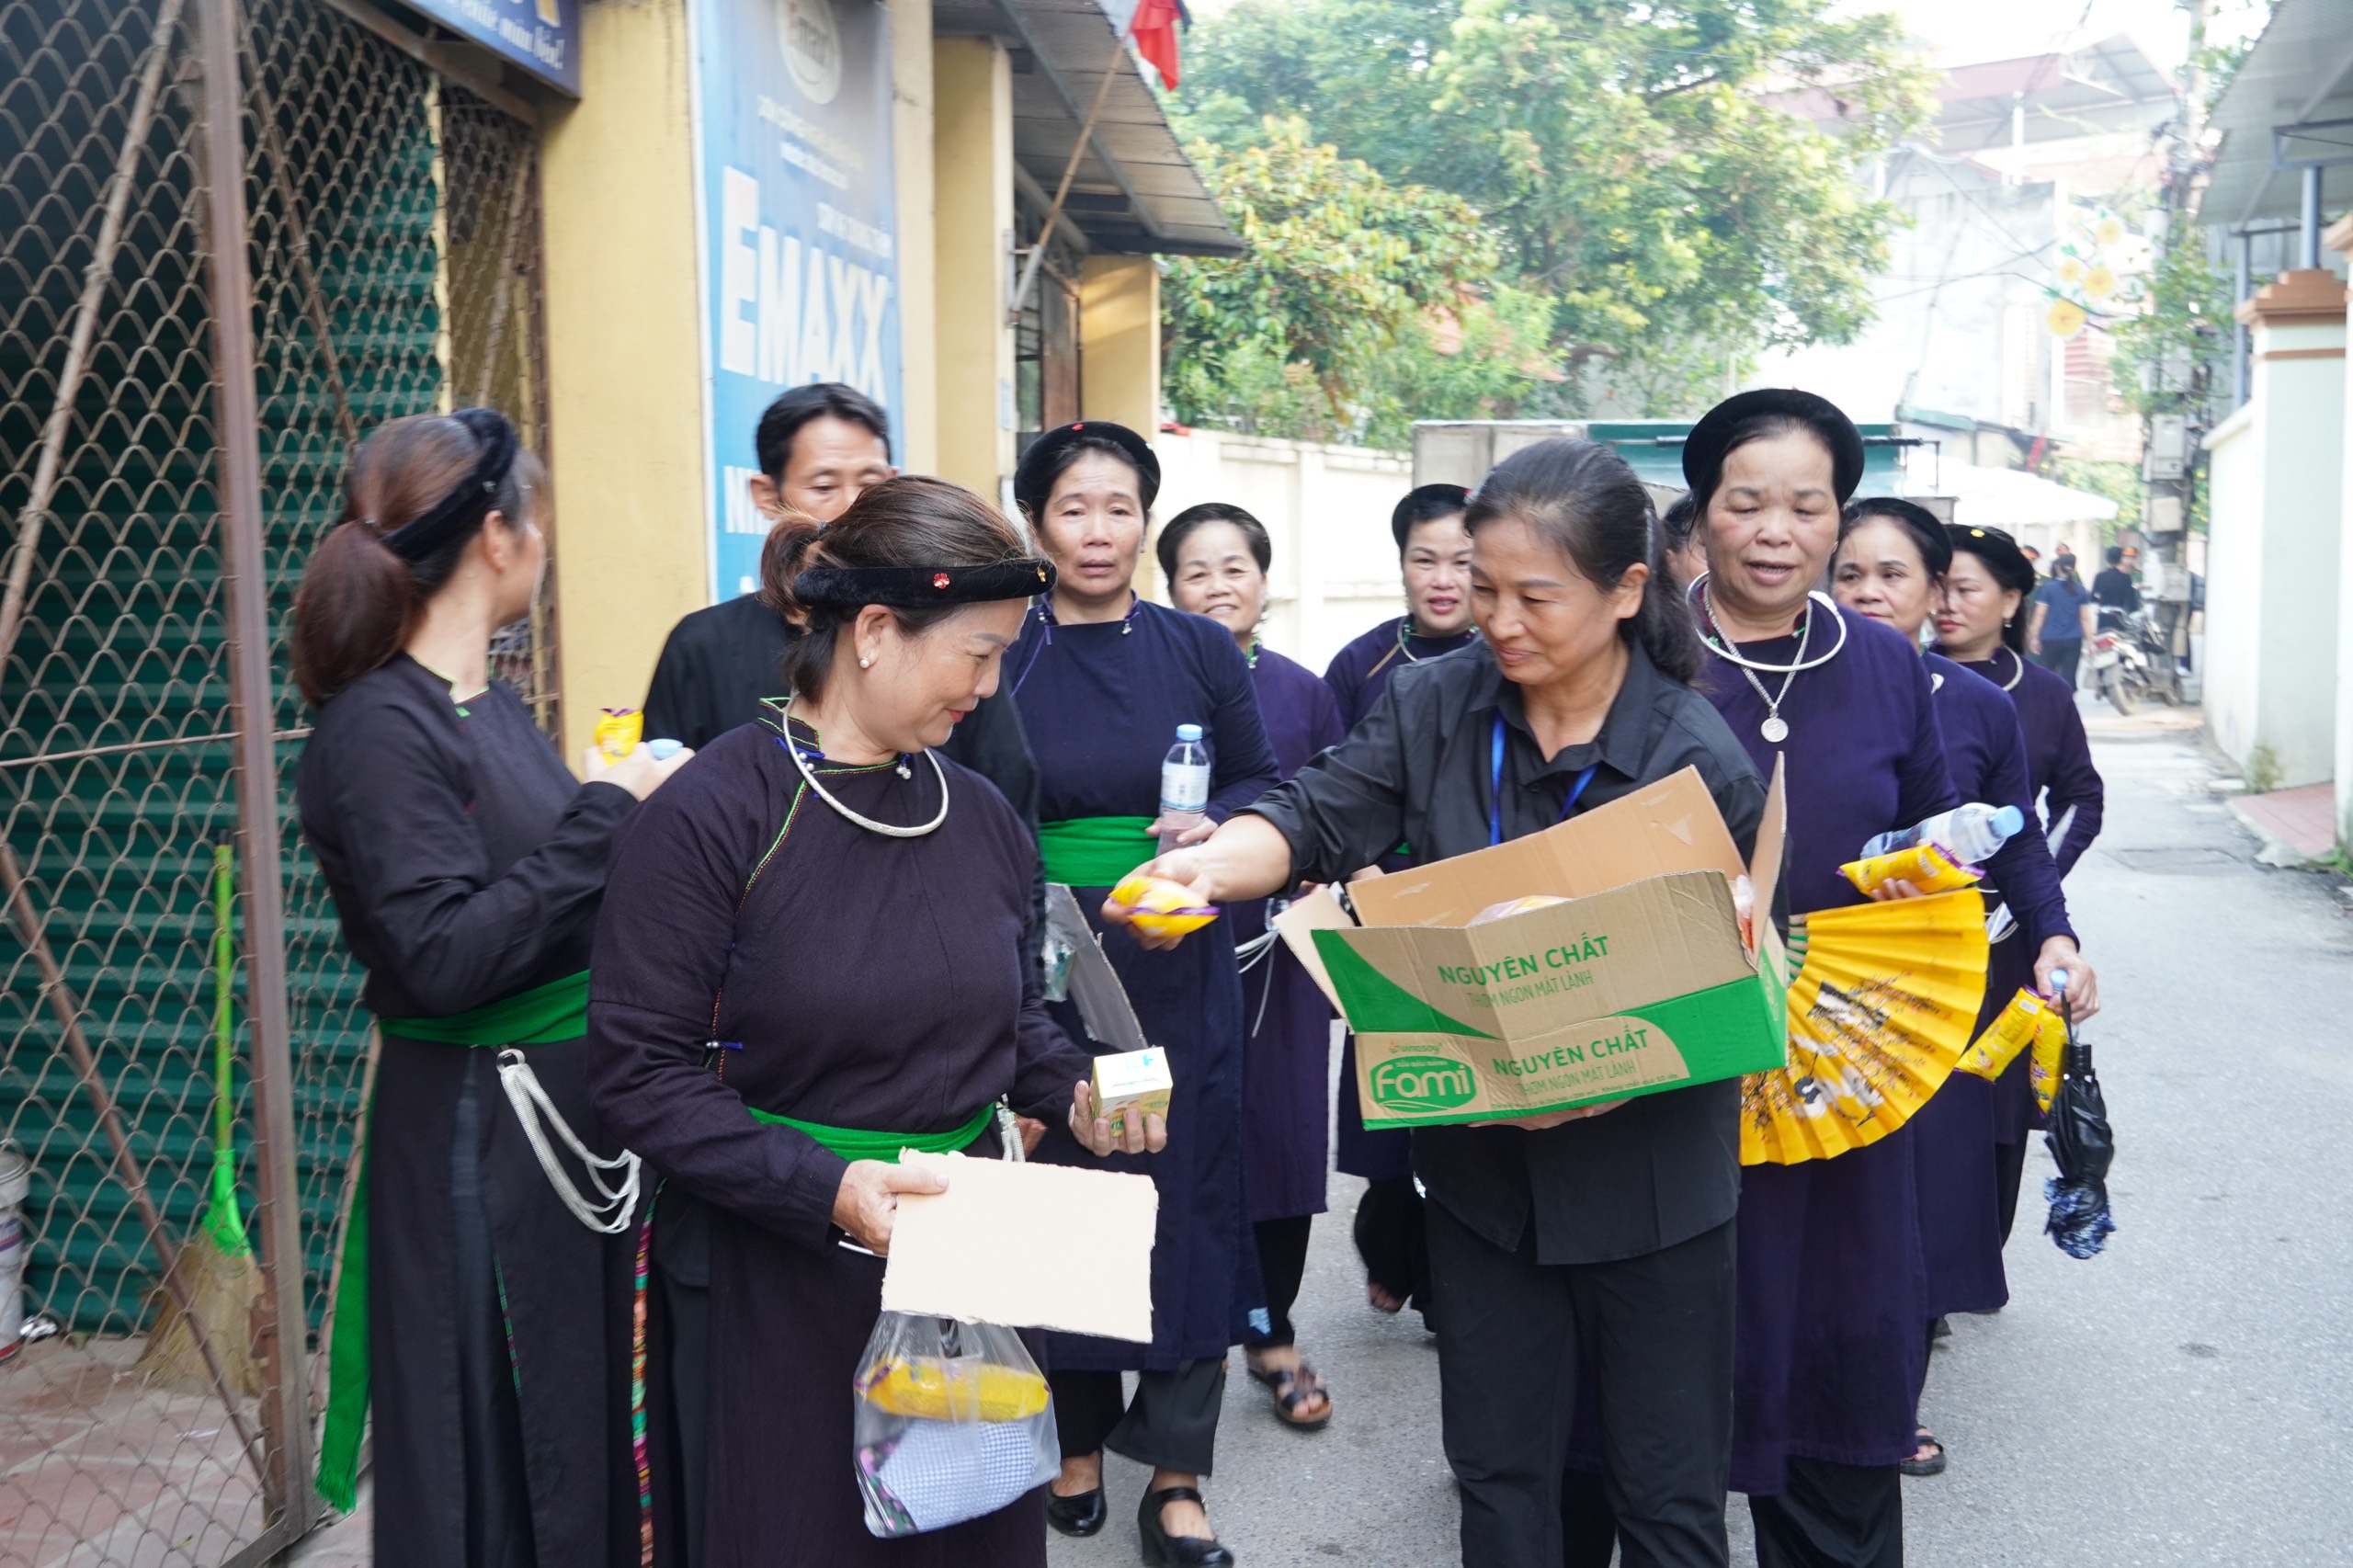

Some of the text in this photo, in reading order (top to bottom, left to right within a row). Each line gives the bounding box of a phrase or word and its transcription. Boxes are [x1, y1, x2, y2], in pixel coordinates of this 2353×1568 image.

[722, 165, 889, 407] EMAXX
[1438, 932, 1608, 986] NGUYÊN CHẤT
[1499, 984, 1535, 1006] NGON
[1534, 976, 1560, 998] MÁT
[1562, 970, 1595, 992] LÀNH
[1492, 1025, 1648, 1077] NGUYÊN CHẤT
[1548, 1073, 1581, 1092] NGON
[1580, 1064, 1604, 1083] MÁT
[1605, 1060, 1636, 1079] LÀNH
